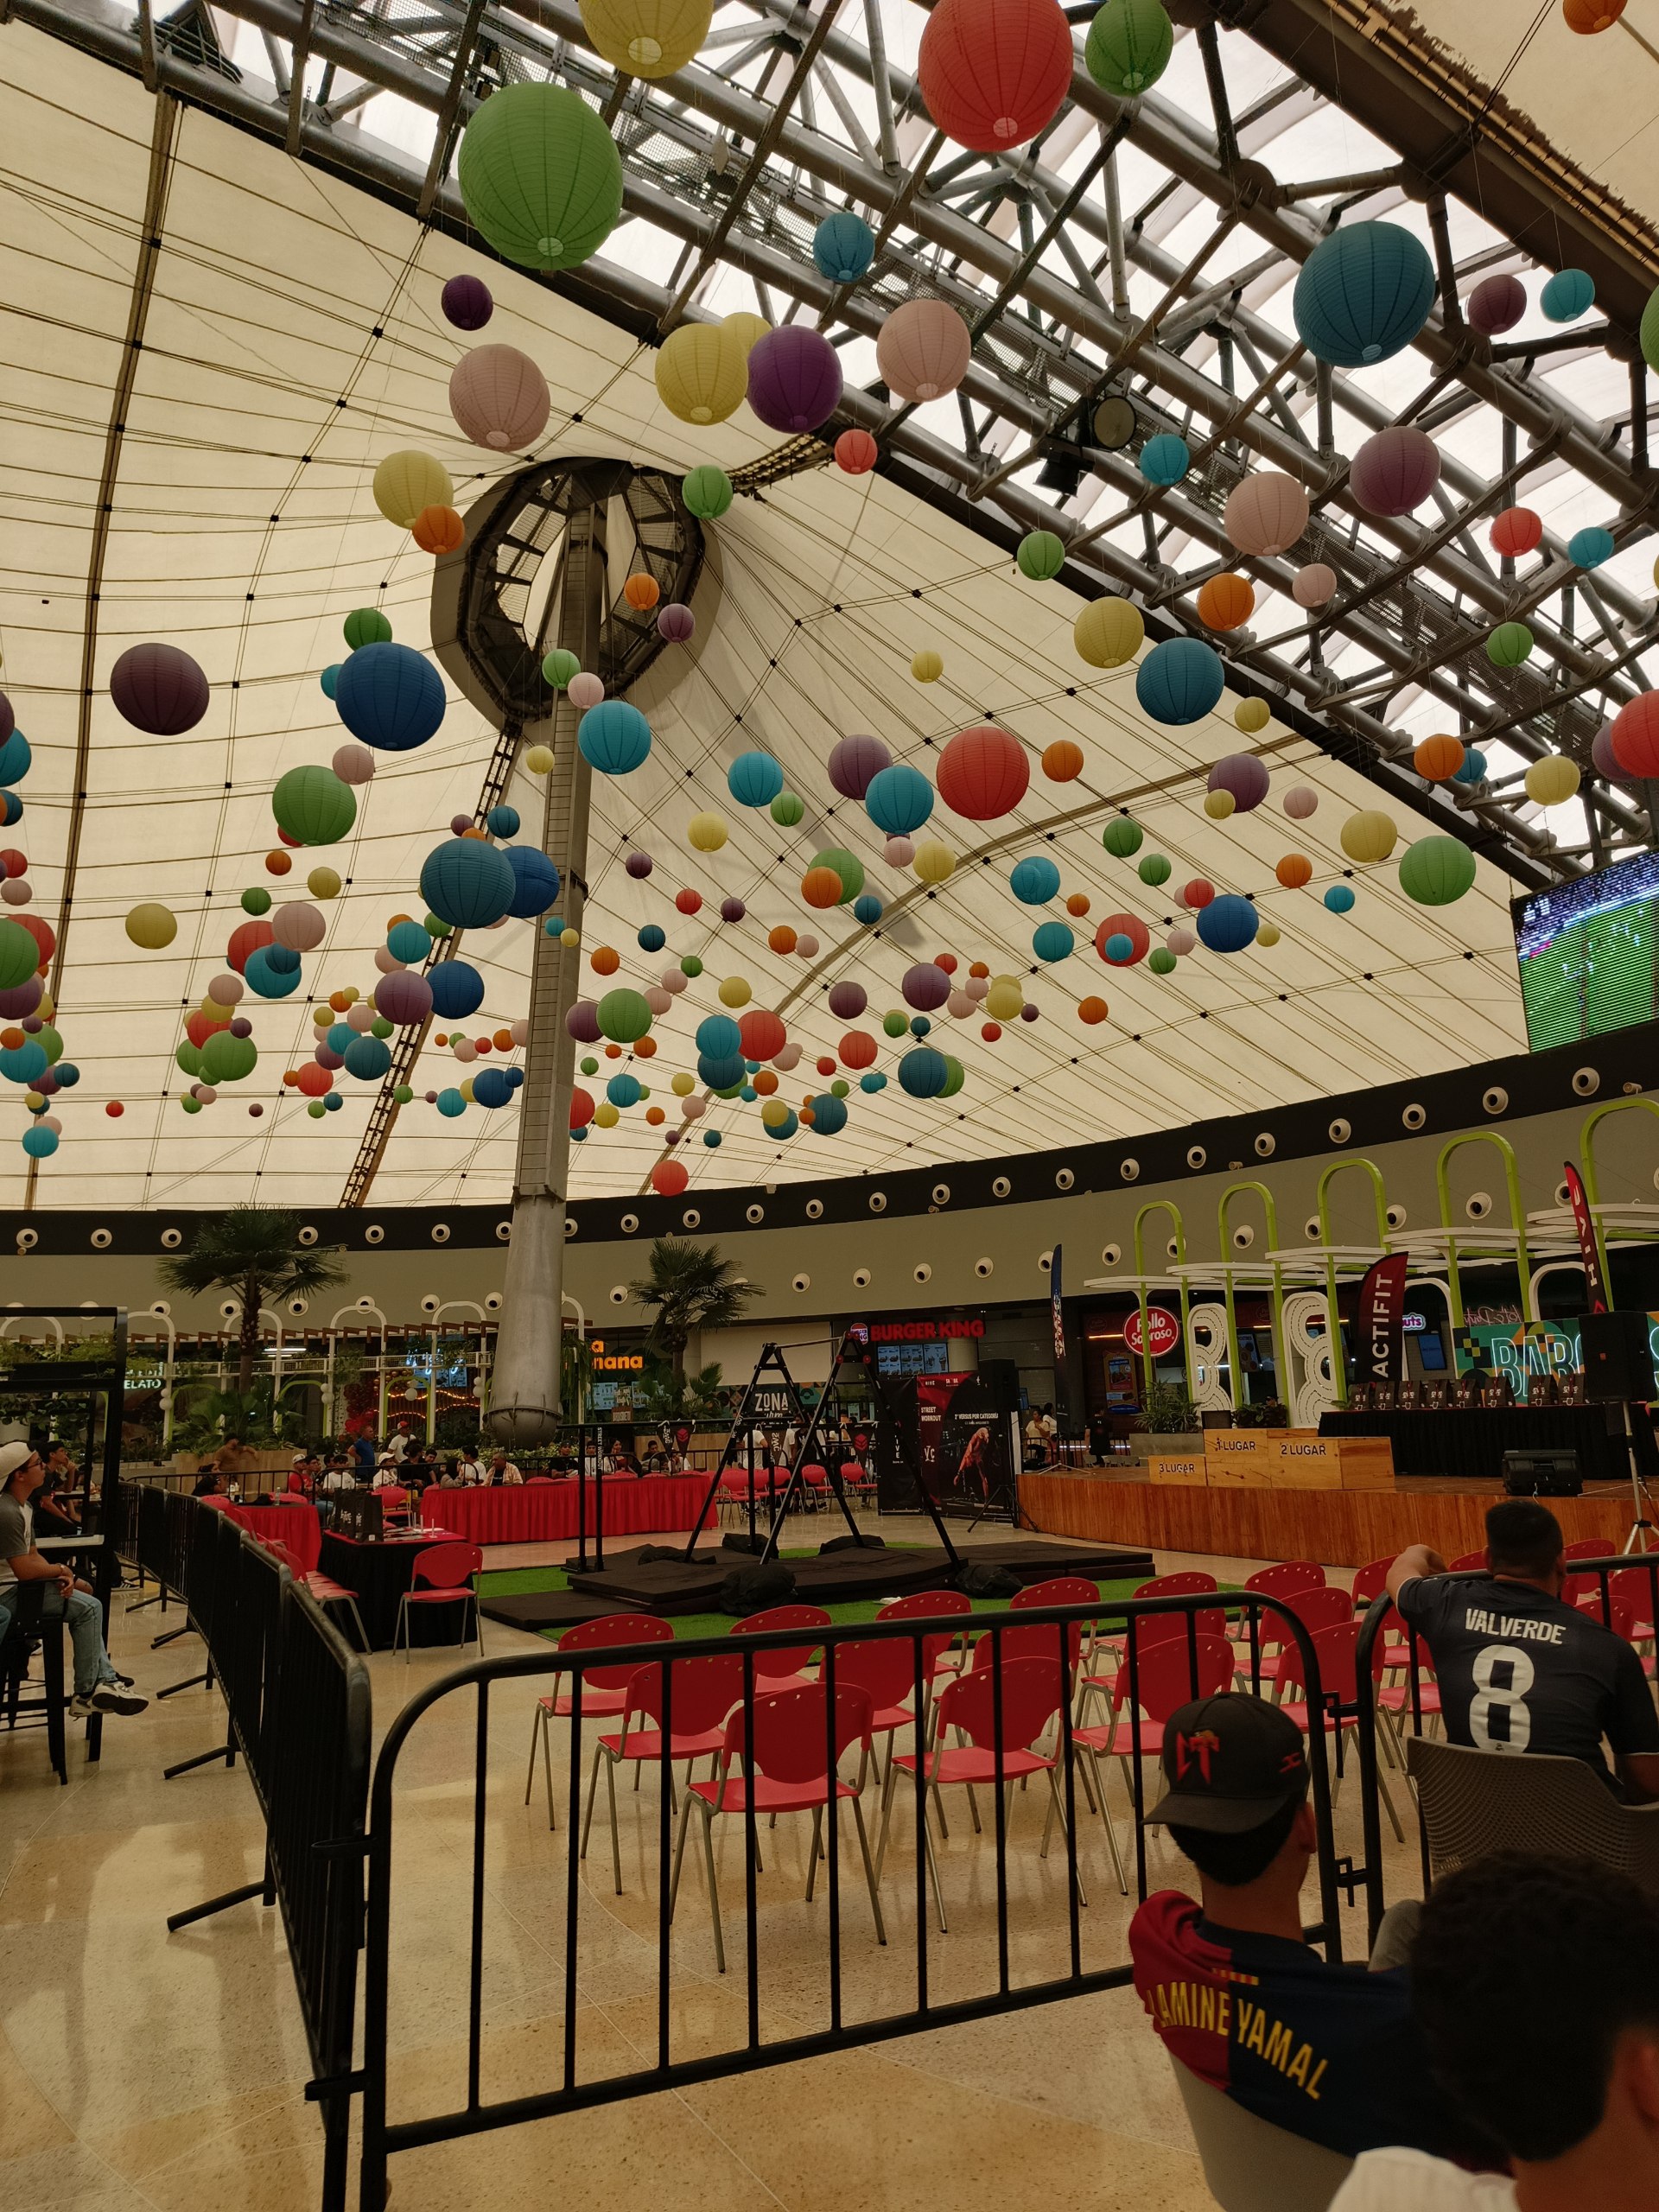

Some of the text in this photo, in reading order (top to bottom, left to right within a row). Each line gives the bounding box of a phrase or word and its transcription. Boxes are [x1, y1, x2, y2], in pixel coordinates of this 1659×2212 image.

[870, 1319, 984, 1341] BURGER KING
[1372, 1274, 1393, 1378] ACTIFIT
[1402, 1316, 1422, 1326] uts
[1131, 1328, 1173, 1345] Saroso
[1491, 1333, 1581, 1397] BAR
[124, 1379, 162, 1389] ELATO
[754, 1392, 789, 1412] ZONA
[1223, 1440, 1256, 1451] LUGAR
[1289, 1444, 1326, 1456] LUGAR
[1165, 1463, 1195, 1473] LUGAR
[1465, 1608, 1567, 1644] VALVERDE
[1469, 1644, 1535, 1753] 8
[1146, 1981, 1328, 2101] LAMINE YAMAL
